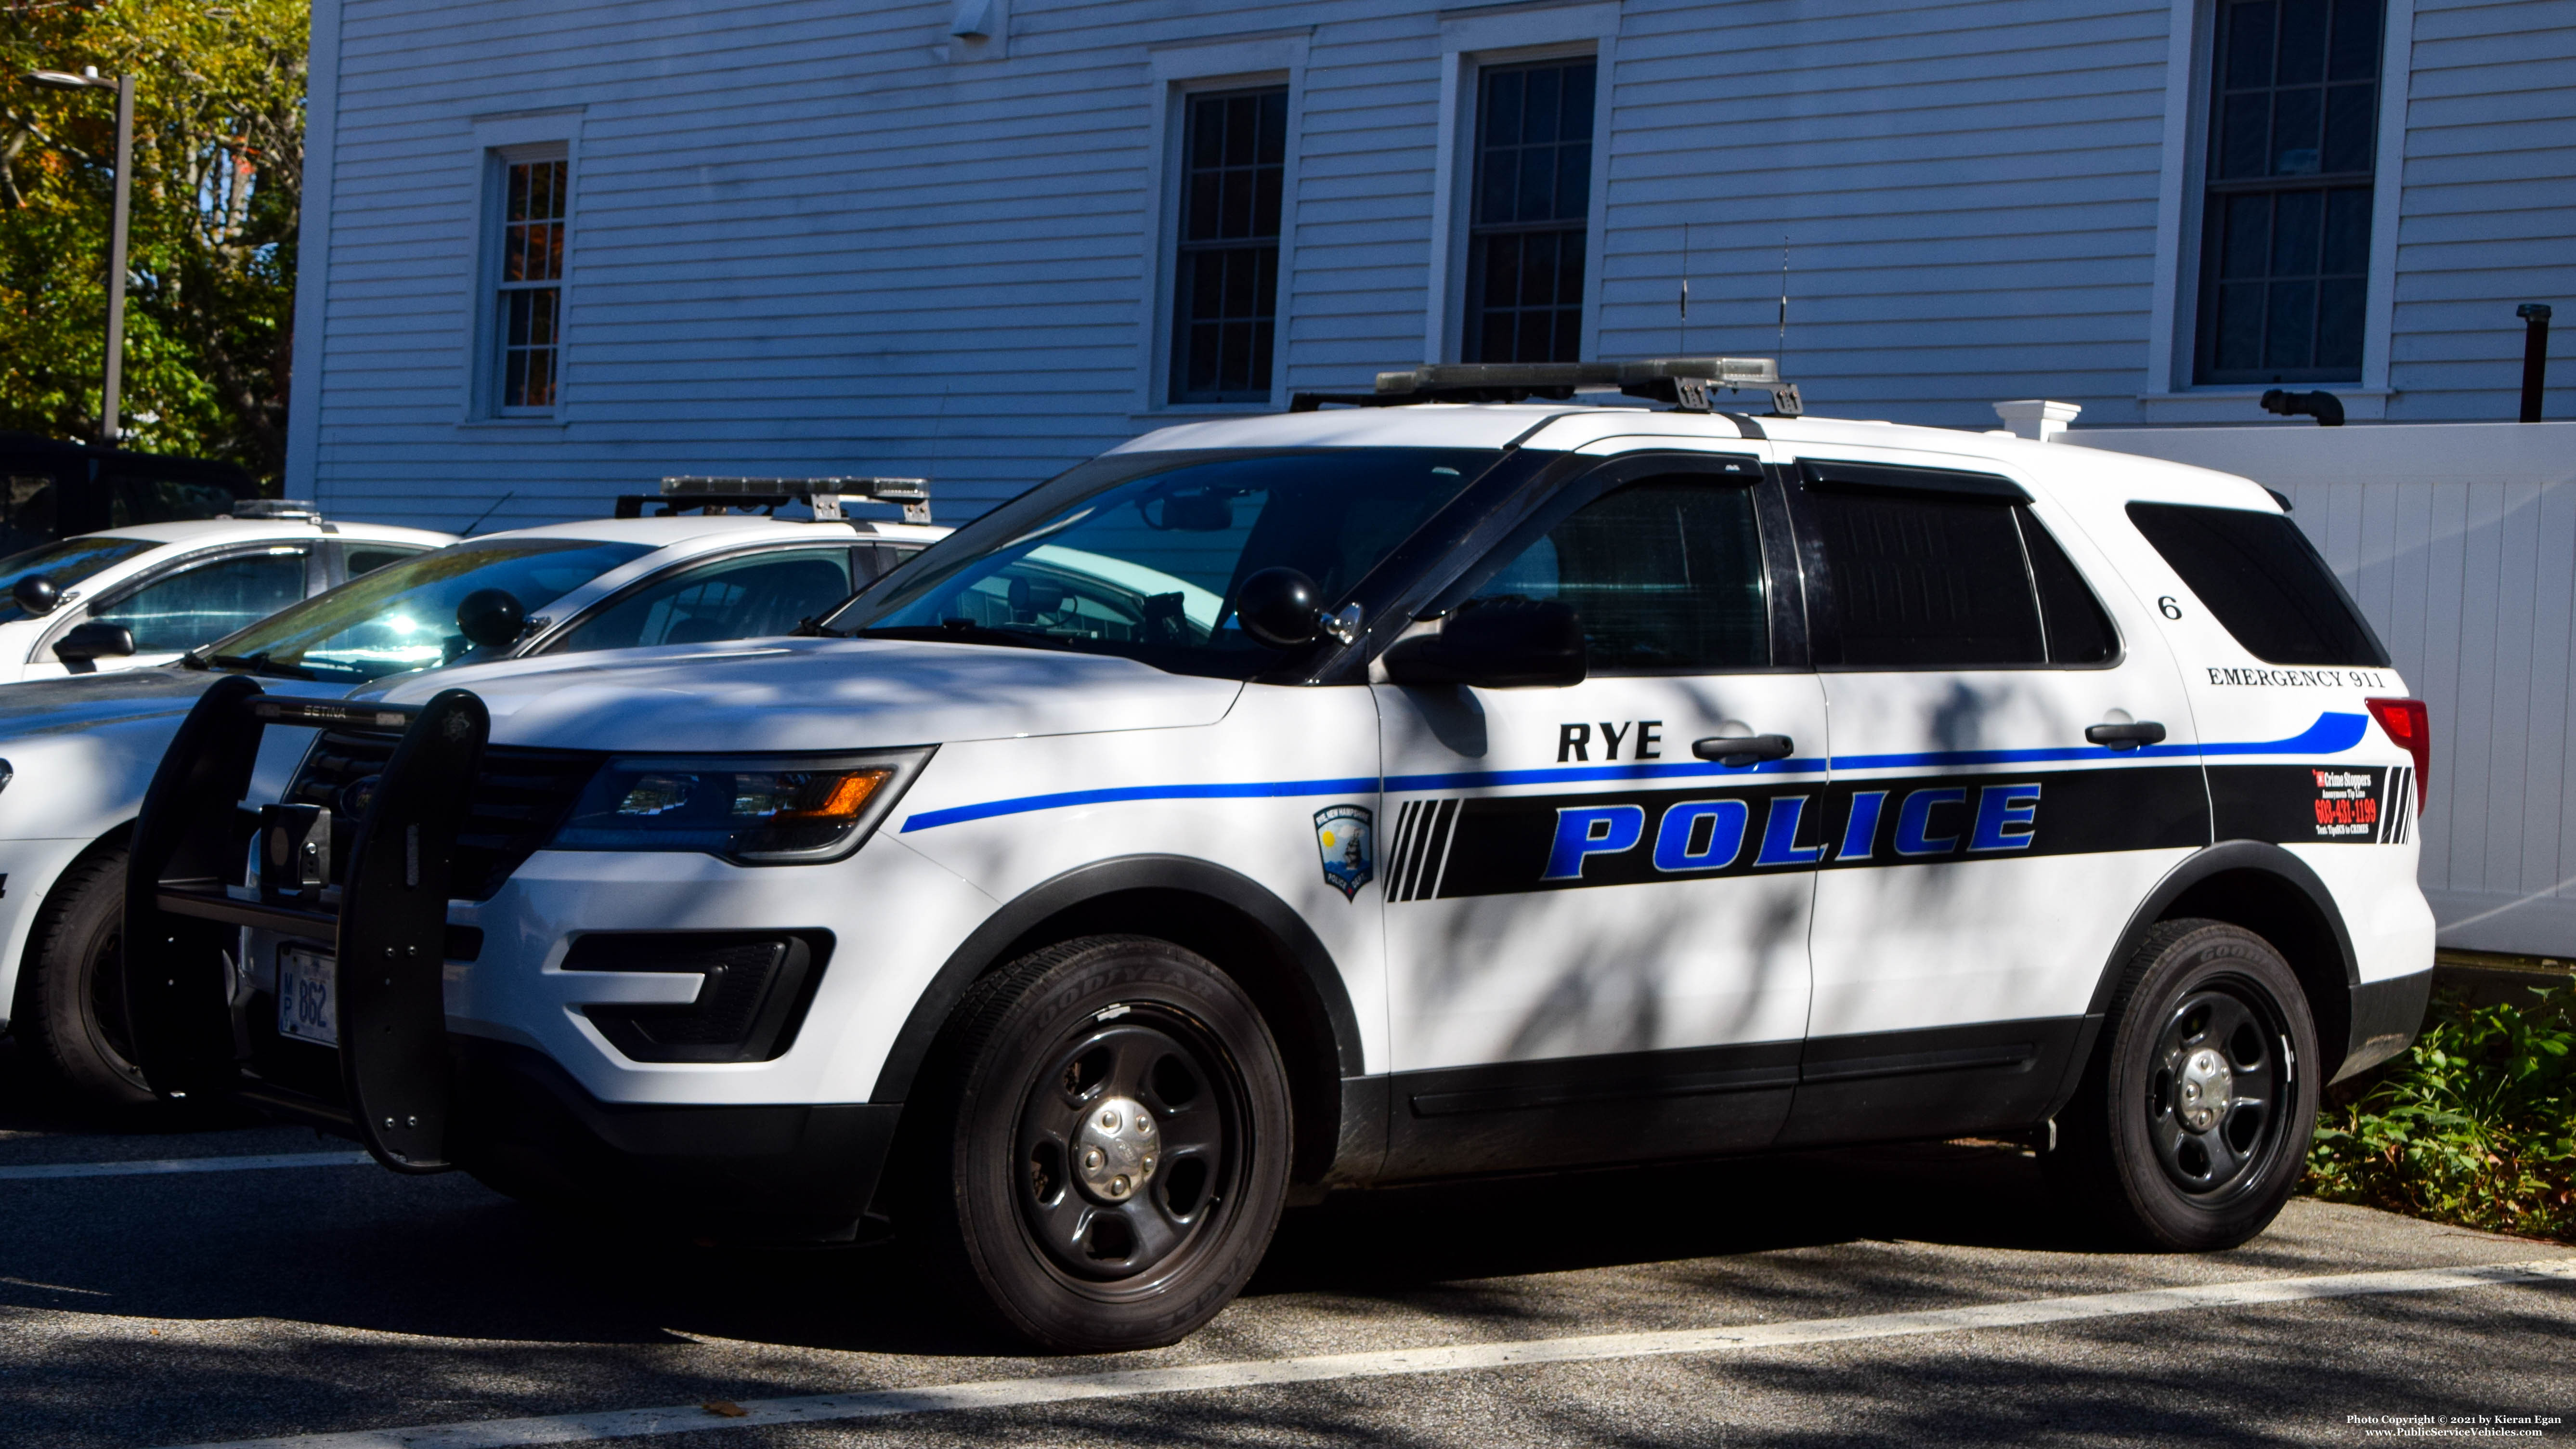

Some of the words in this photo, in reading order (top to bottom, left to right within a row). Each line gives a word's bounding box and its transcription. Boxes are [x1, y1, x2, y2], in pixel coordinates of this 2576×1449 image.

[2158, 596, 2183, 620] 6
[2206, 668, 2344, 687] EMERGENCY
[2349, 672, 2386, 689] 911
[303, 705, 346, 718] SETINA
[1557, 720, 1663, 763] RYE
[2324, 771, 2343, 787] Crime
[2344, 771, 2371, 790] Stoppers
[2315, 798, 2377, 824] 603-431-1199
[1540, 782, 2042, 880] POLICE
[2350, 823, 2369, 835] CRIMES
[299, 979, 326, 1028] 862
